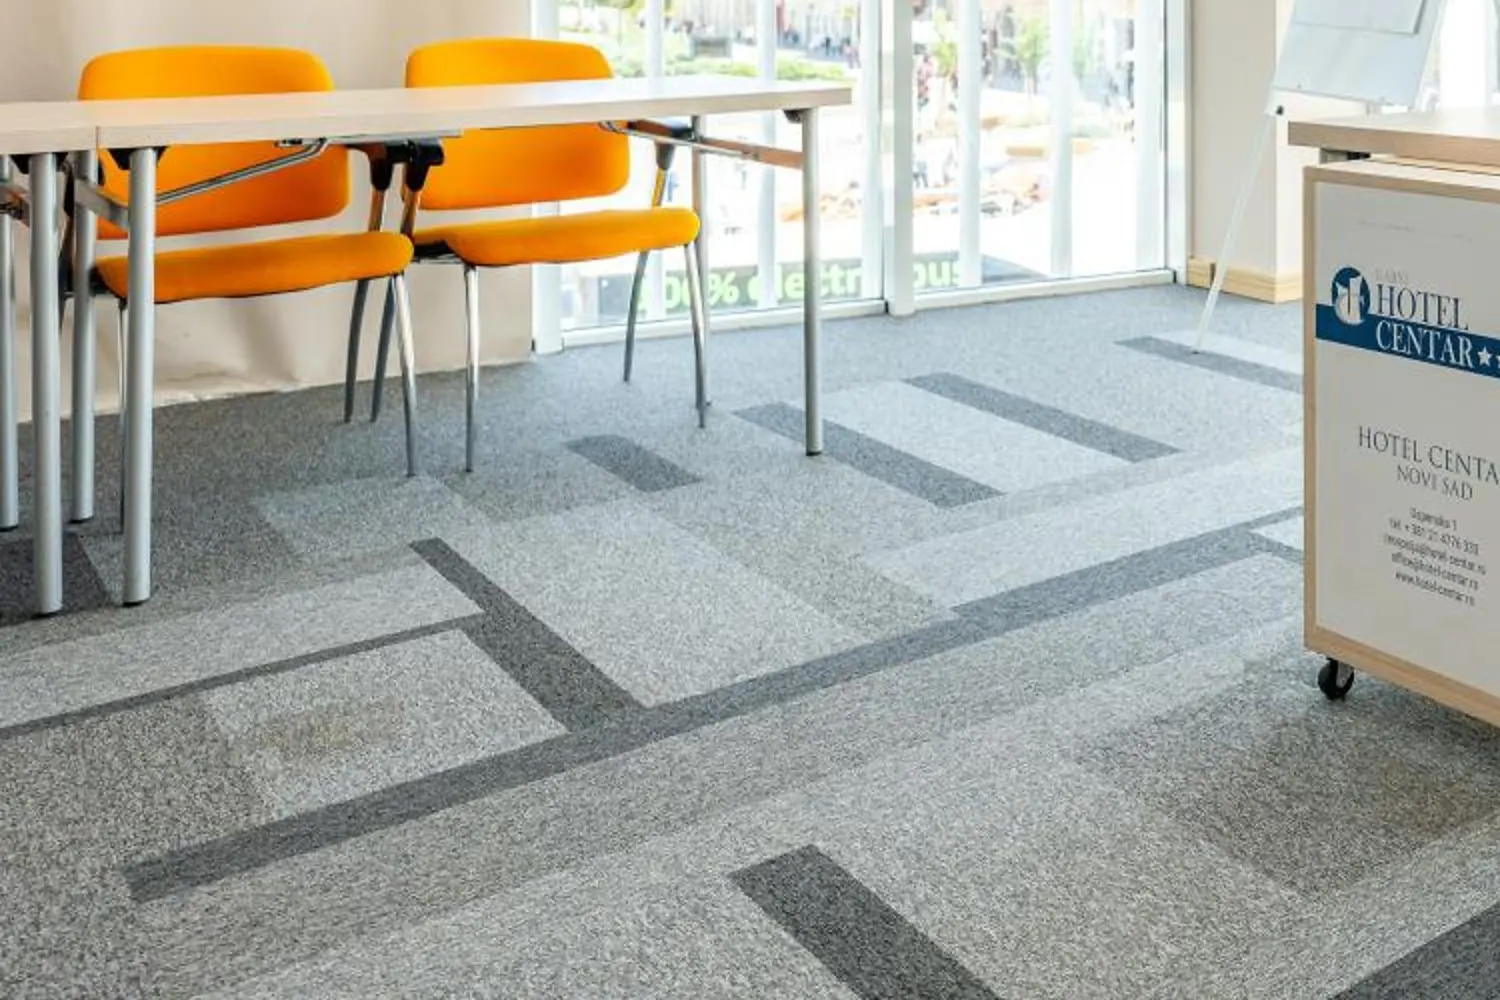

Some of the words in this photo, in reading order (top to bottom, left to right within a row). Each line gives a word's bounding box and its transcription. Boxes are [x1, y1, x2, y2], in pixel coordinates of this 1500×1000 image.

[1376, 283, 1469, 330] HOTEL
[1376, 319, 1474, 369] CENTAR
[1358, 425, 1423, 463] HOTEL
[1397, 464, 1438, 490] NOVI
[1440, 477, 1473, 501] SAD
